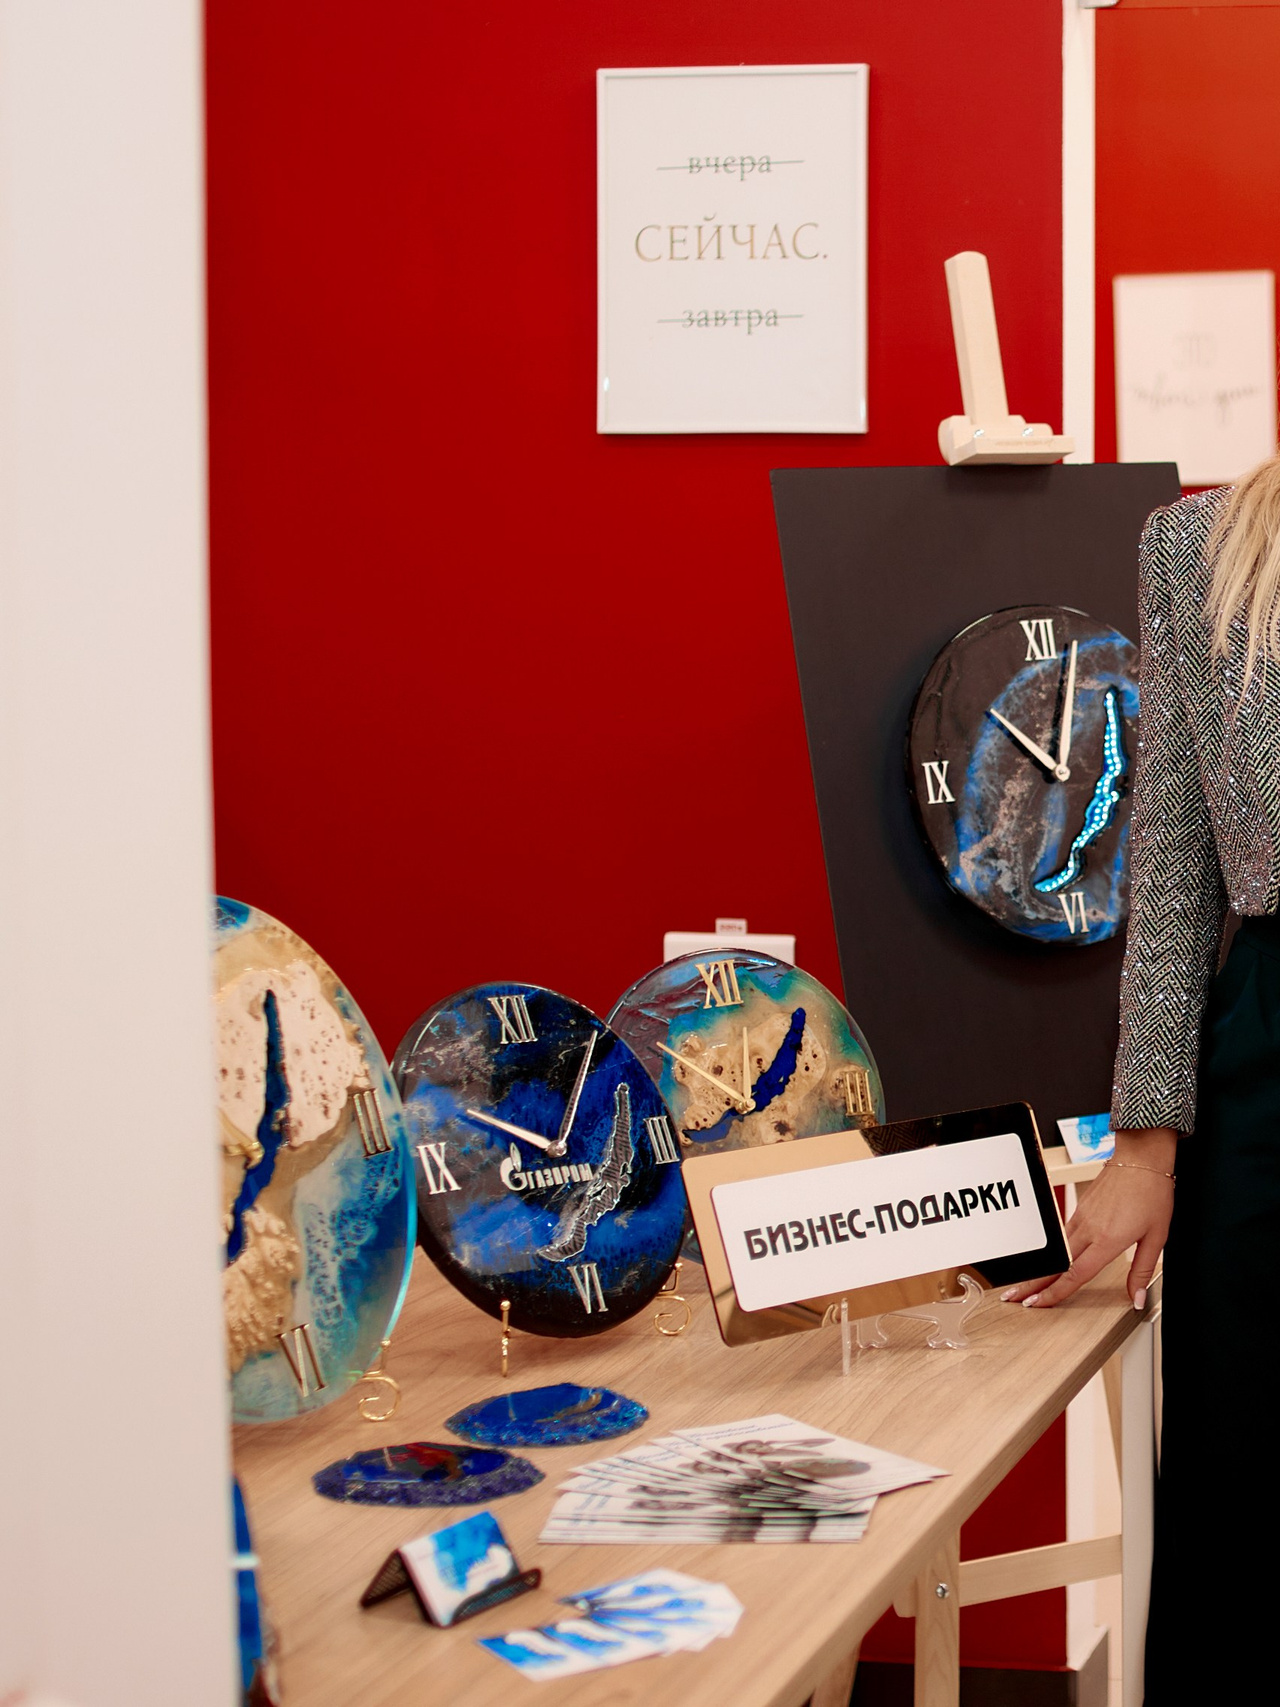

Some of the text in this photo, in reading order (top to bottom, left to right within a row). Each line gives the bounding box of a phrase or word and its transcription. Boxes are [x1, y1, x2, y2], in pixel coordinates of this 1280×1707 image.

[688, 154, 772, 181] вчера
[634, 213, 829, 262] СЕЙЧАС.
[681, 308, 779, 335] завтра
[1020, 618, 1057, 661] XII
[922, 760, 955, 804] IX
[1058, 891, 1090, 934] VI
[695, 959, 744, 1010] XII
[488, 994, 538, 1045] XII
[417, 1142, 462, 1195] IX
[743, 1178, 1021, 1261] БИЗНЕС-ПОДАРКИ
[567, 1262, 609, 1314] VI
